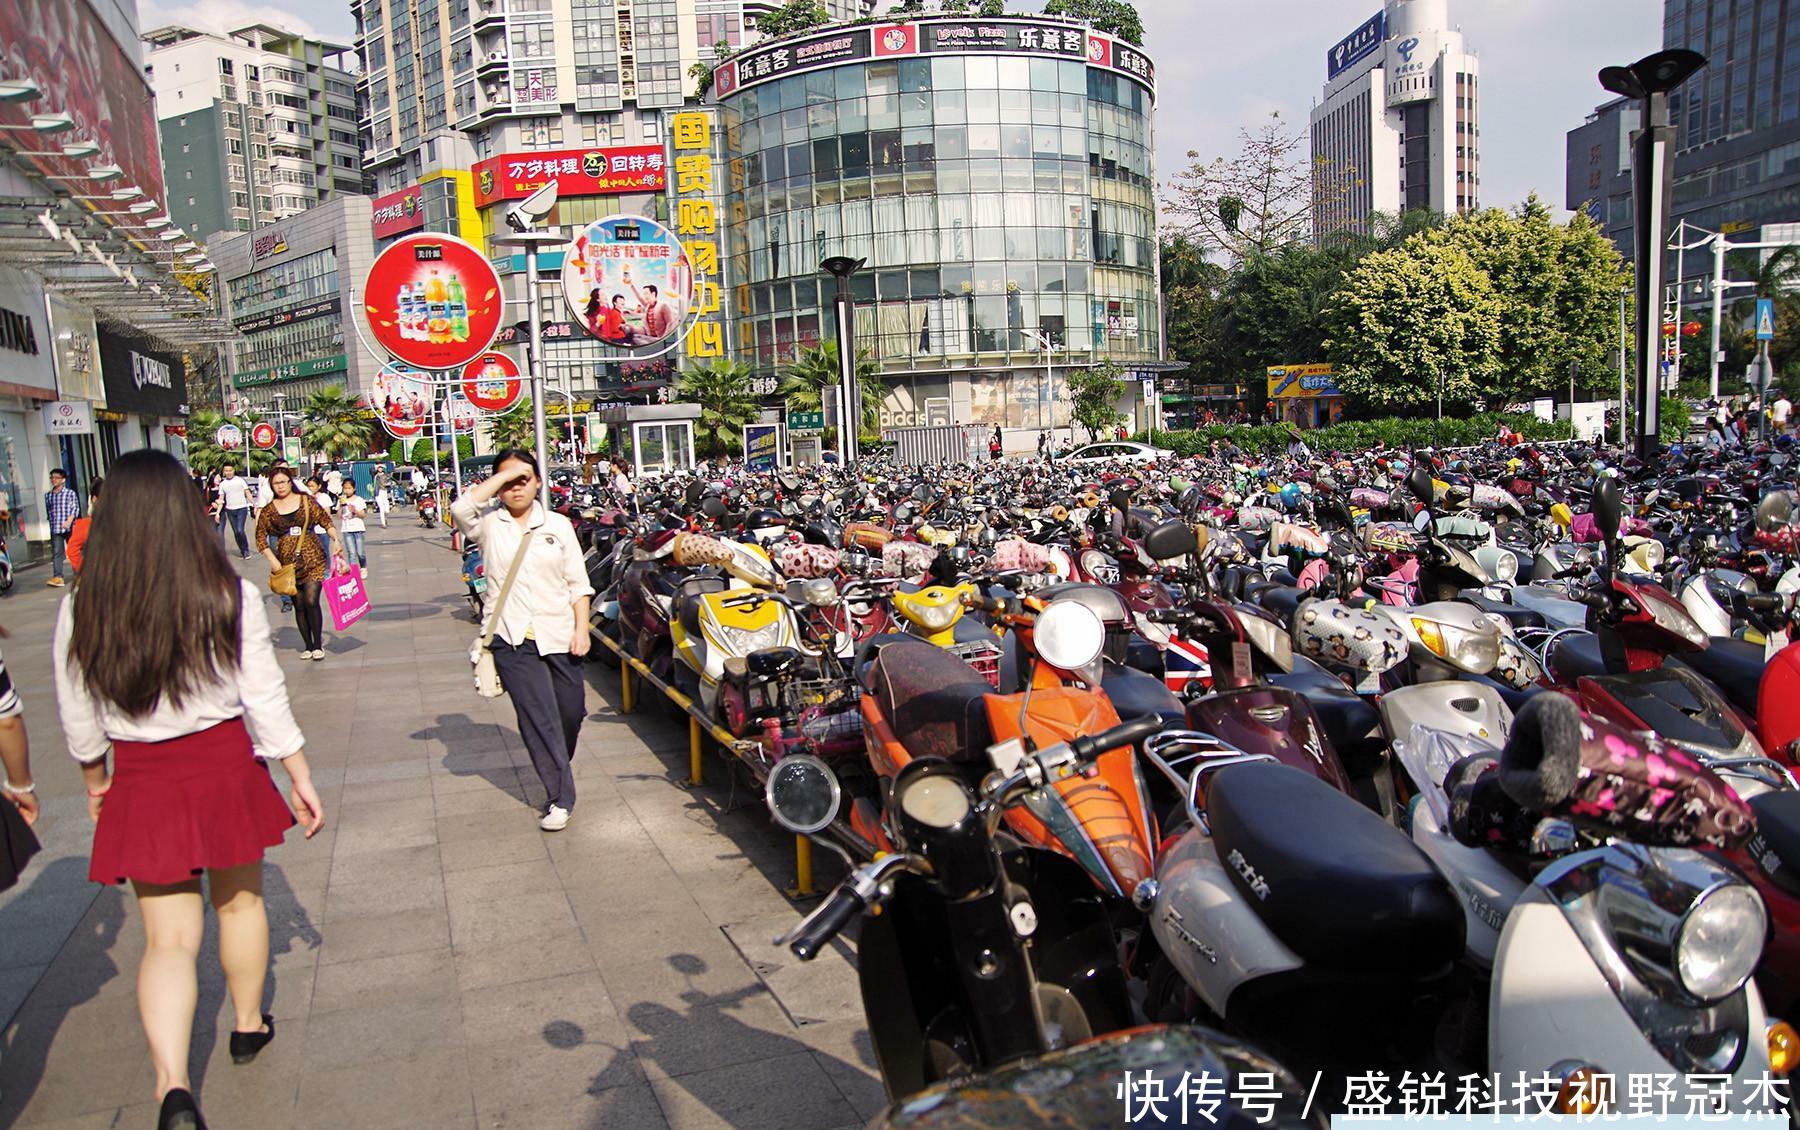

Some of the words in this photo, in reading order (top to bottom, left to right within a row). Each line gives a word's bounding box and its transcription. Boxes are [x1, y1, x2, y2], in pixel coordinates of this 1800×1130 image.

[978, 26, 1007, 38] Pizza
[1018, 28, 1081, 51] 乐意客
[741, 49, 789, 81] 乐意客
[1395, 62, 1423, 75] 中国电信
[673, 112, 724, 358] 国贸购物中心
[880, 410, 926, 427] didas
